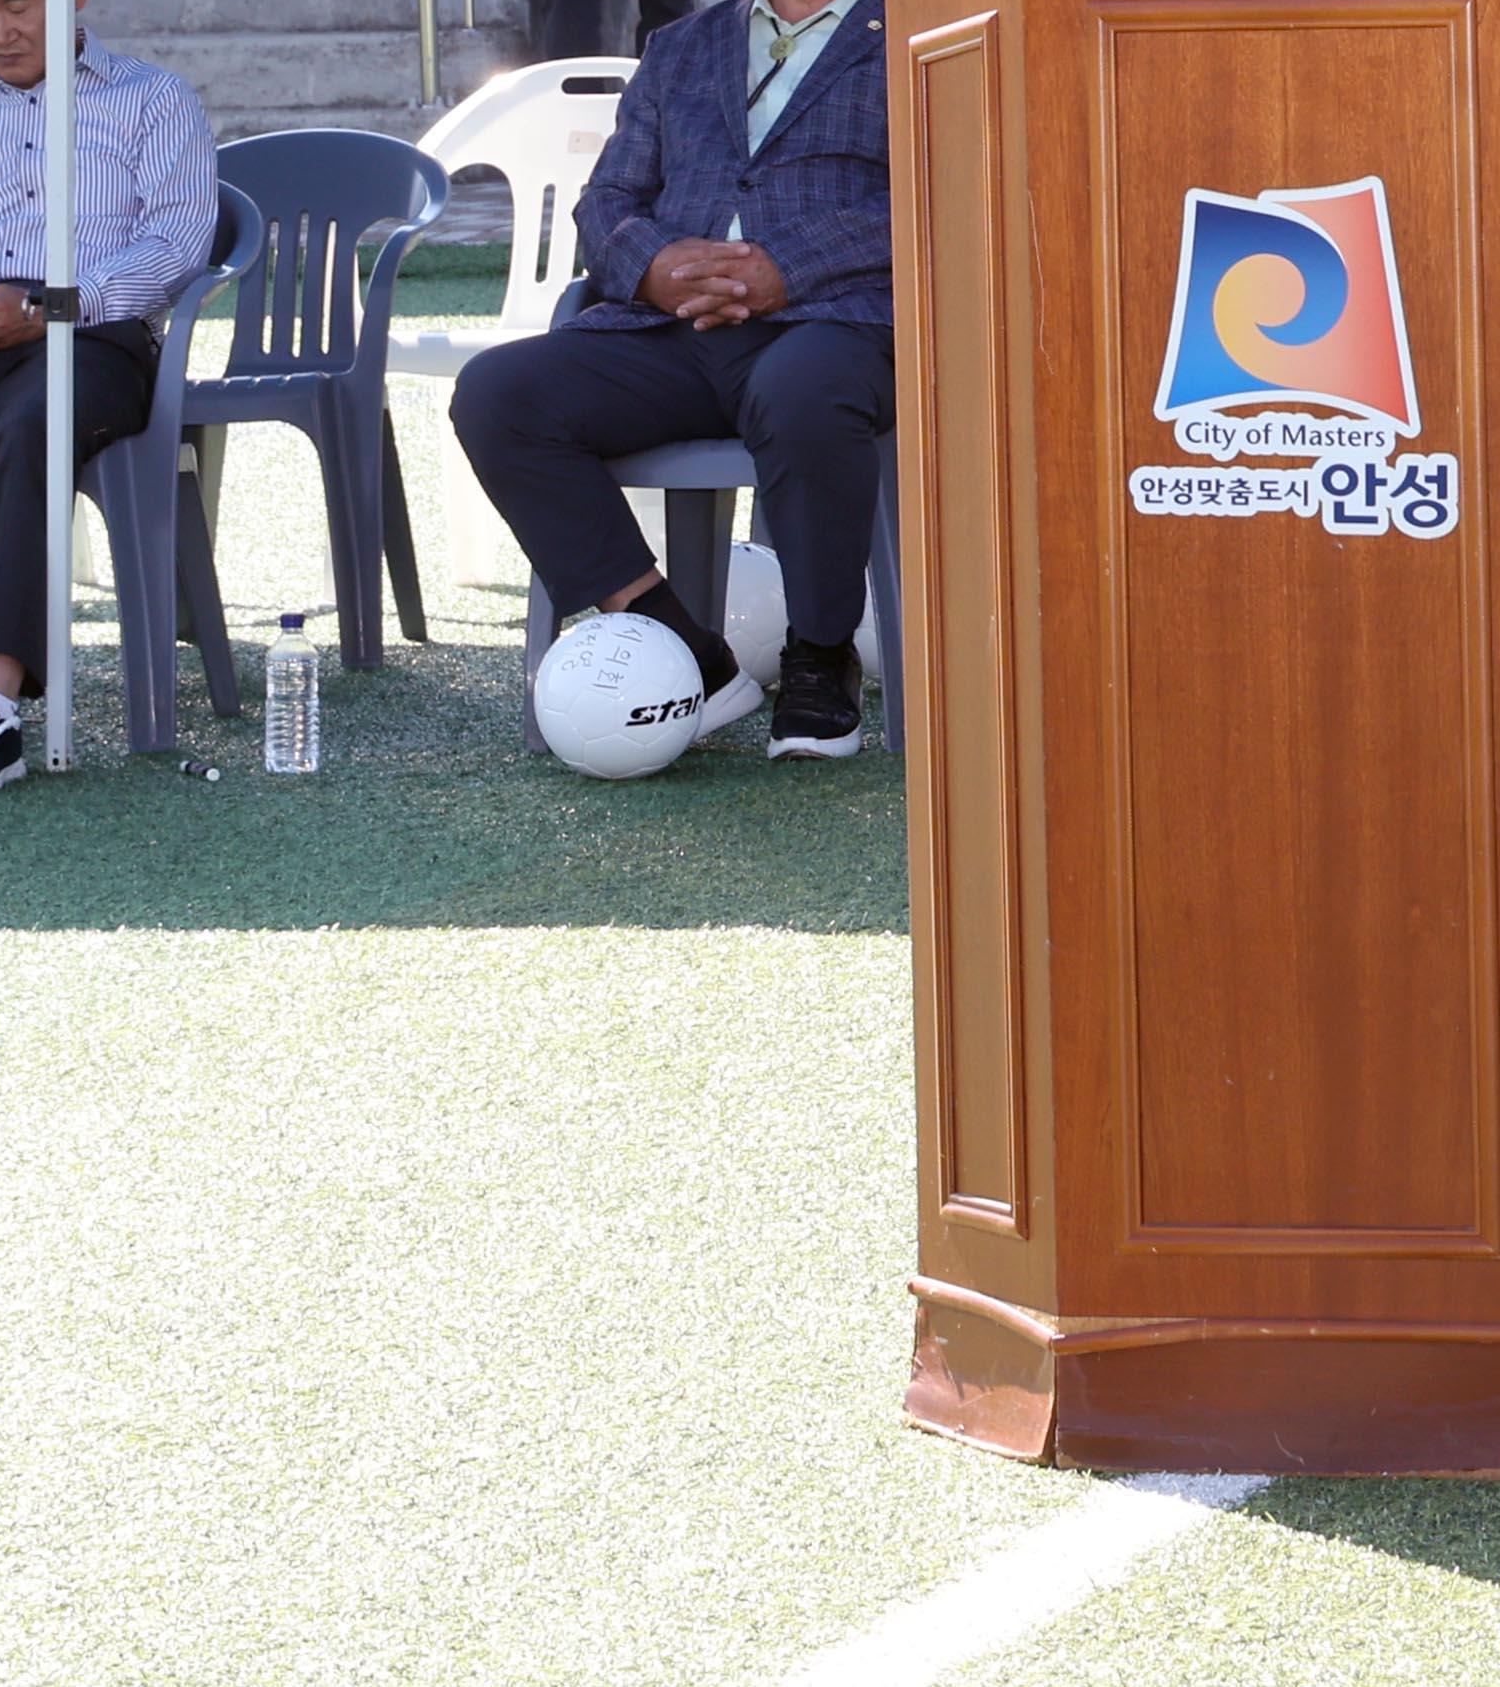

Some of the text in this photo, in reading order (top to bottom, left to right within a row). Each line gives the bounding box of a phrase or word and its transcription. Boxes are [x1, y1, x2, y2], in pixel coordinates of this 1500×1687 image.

[1185, 421, 1386, 450] City of Masters
[1140, 462, 1449, 528] 안성맞춤도시 안성
